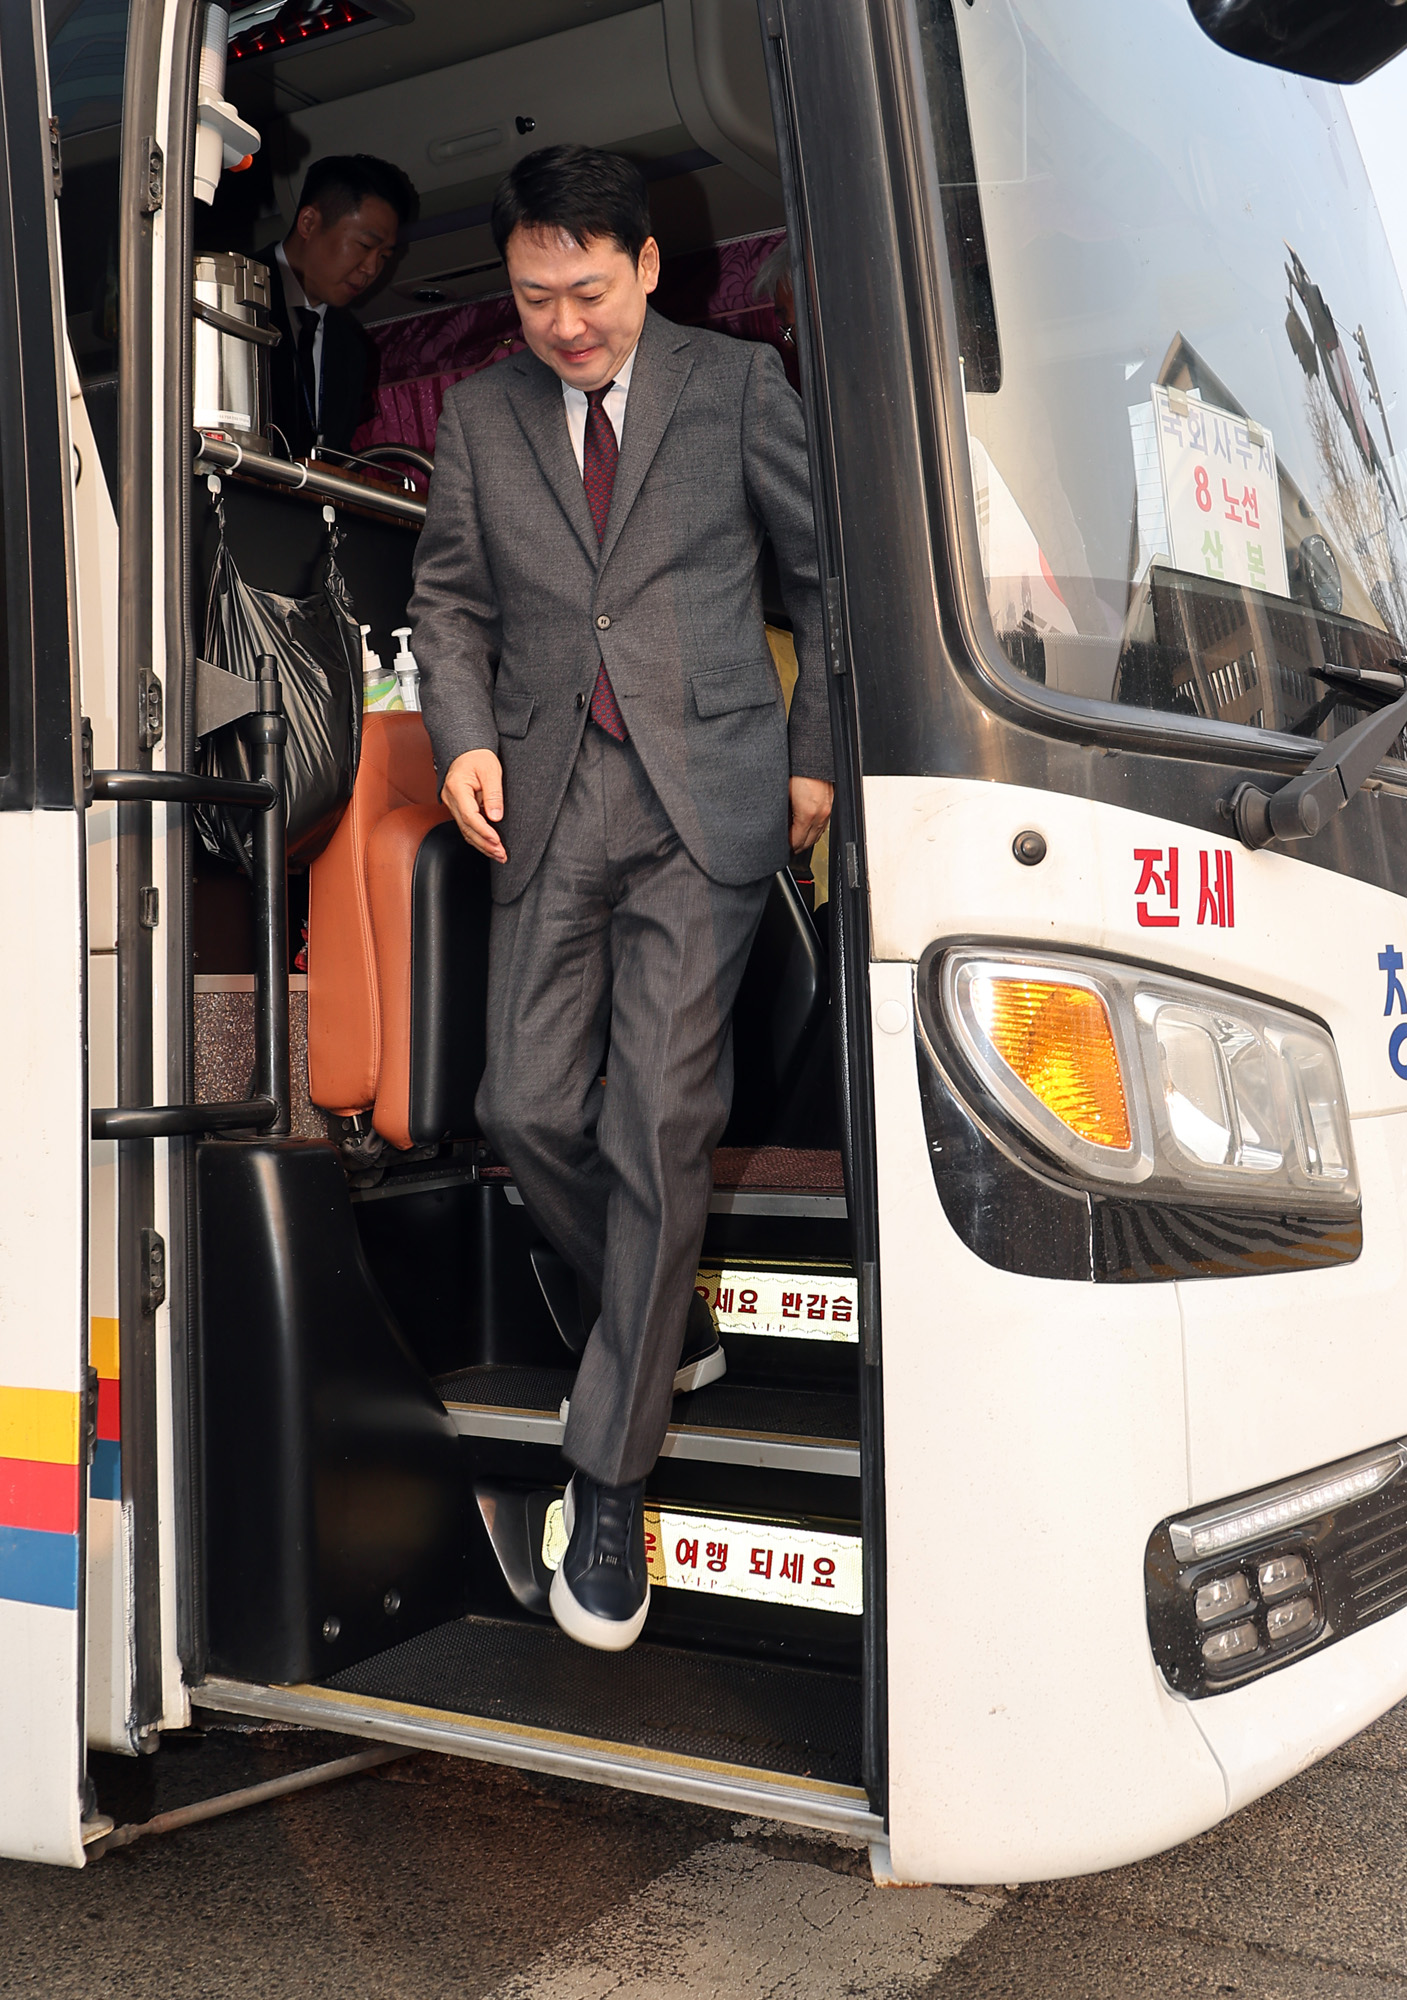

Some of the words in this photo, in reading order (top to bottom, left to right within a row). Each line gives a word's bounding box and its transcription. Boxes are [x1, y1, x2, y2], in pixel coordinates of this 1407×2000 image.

[1193, 465, 1213, 513] 8
[1221, 477, 1261, 530] 노선
[675, 1538, 729, 1572] 여행
[749, 1548, 836, 1589] 되세요
